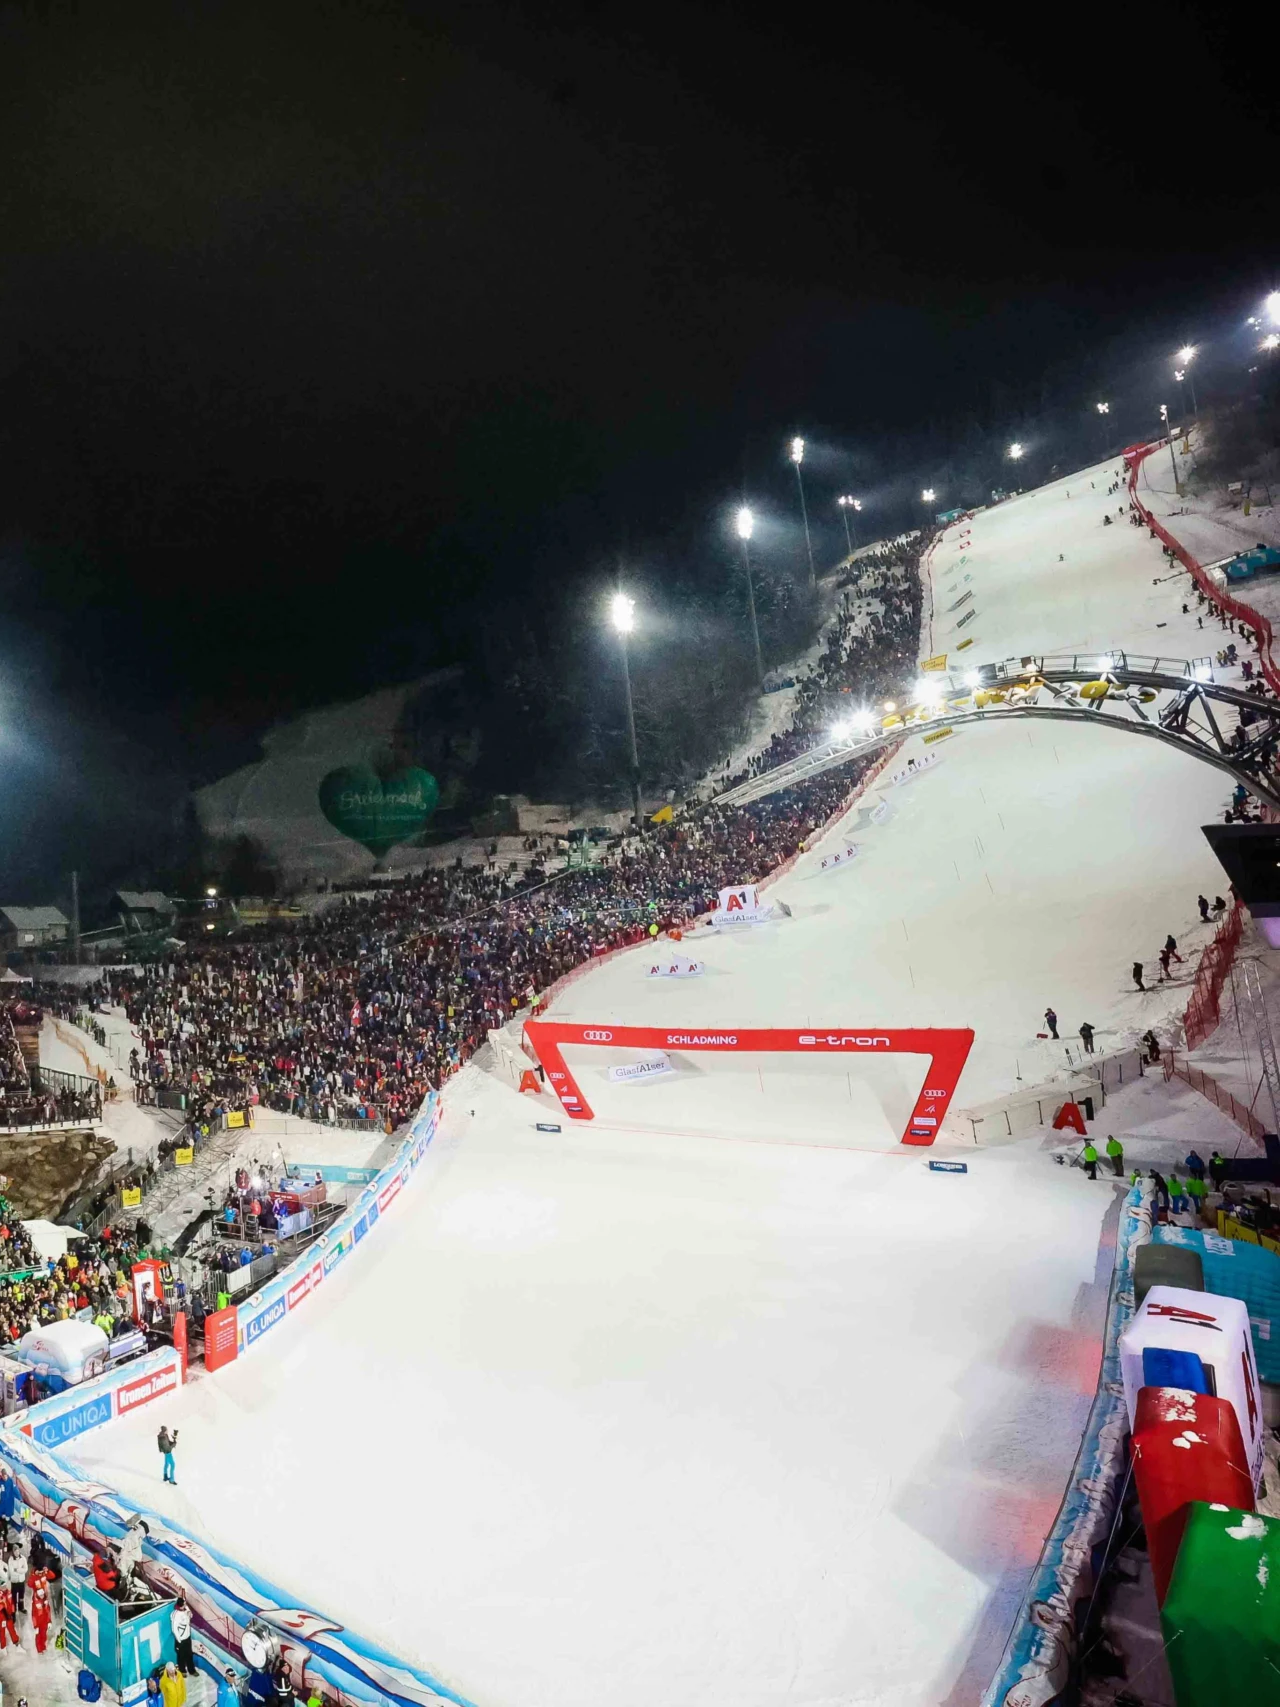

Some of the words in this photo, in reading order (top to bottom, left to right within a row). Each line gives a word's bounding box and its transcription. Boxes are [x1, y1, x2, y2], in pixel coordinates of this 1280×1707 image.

[726, 891, 747, 912] A1
[650, 965, 659, 974] A1
[669, 965, 678, 973] A1
[688, 963, 698, 972] A1
[666, 1035, 737, 1045] SCHLADMING
[798, 1036, 890, 1046] e-tron
[1052, 1096, 1095, 1135] A1
[260, 1303, 285, 1328] UNIQA
[120, 1382, 151, 1408] Kronen
[62, 1403, 108, 1436] UNIQA
